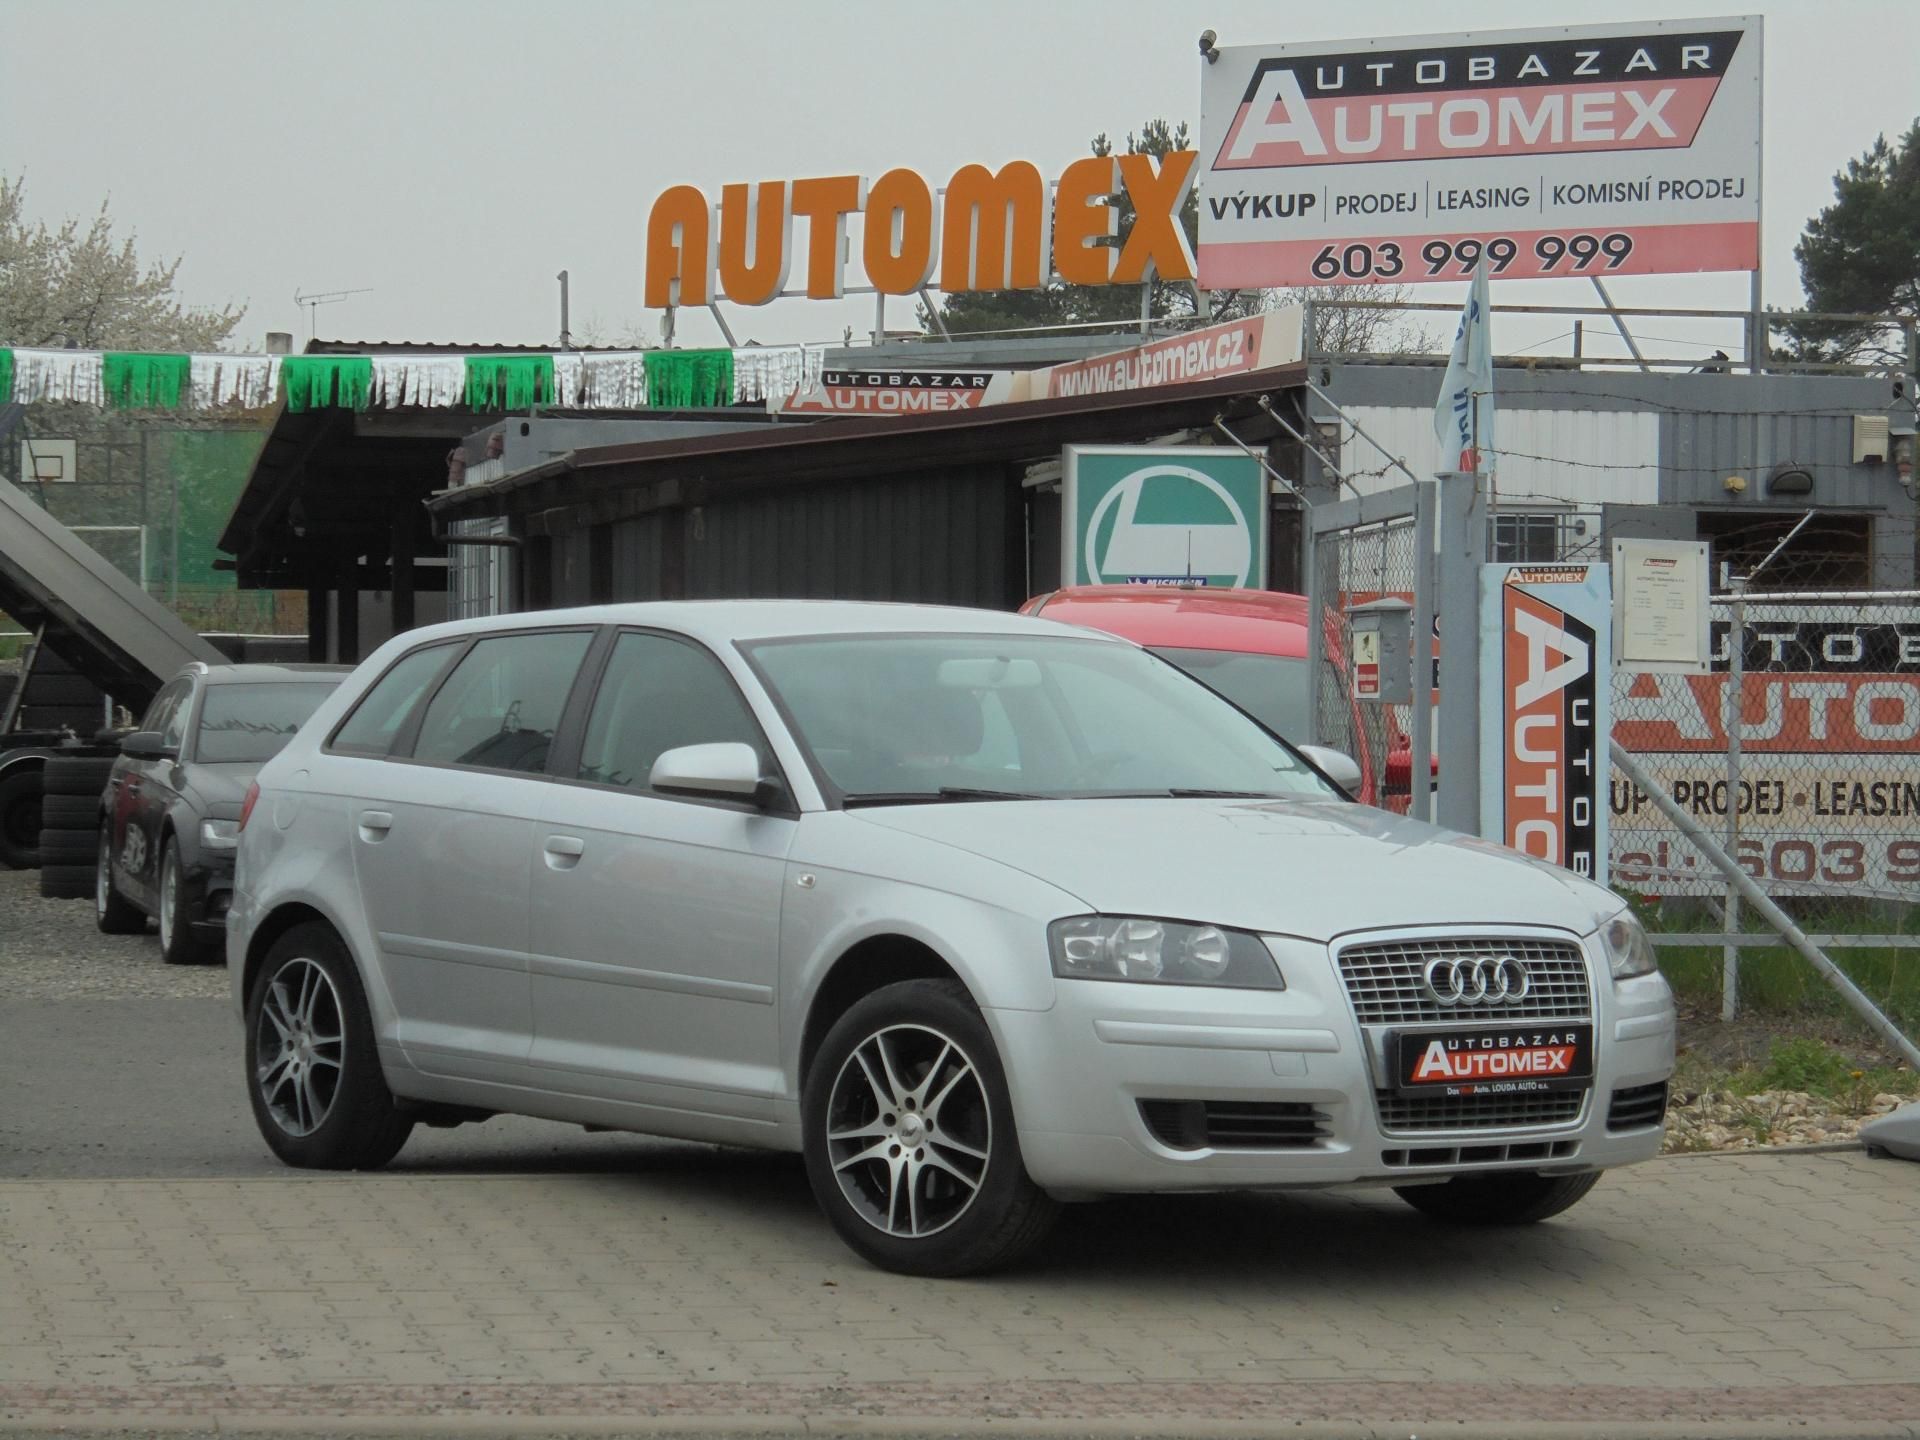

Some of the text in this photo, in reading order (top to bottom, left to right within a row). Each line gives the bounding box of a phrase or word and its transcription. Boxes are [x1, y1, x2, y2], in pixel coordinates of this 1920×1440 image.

[1227, 68, 1678, 160] AUTOMEX
[1209, 175, 1746, 220] VÝKUP PRODEJ LEASING KOMISNÍ PRODEJ
[644, 150, 1199, 309] AUTOMEX
[1311, 232, 1634, 280] 603 999 999
[1059, 329, 1244, 397] www.automex.cz
[791, 383, 973, 411] AUTOMEX
[1505, 567, 1582, 583] AUTOMEX
[1673, 780, 1784, 816] PRODEJ
[1418, 1041, 1566, 1077] AUTOMEX
[1491, 1083, 1516, 1093] LOUDA
[1518, 1081, 1537, 1091] AUTO
